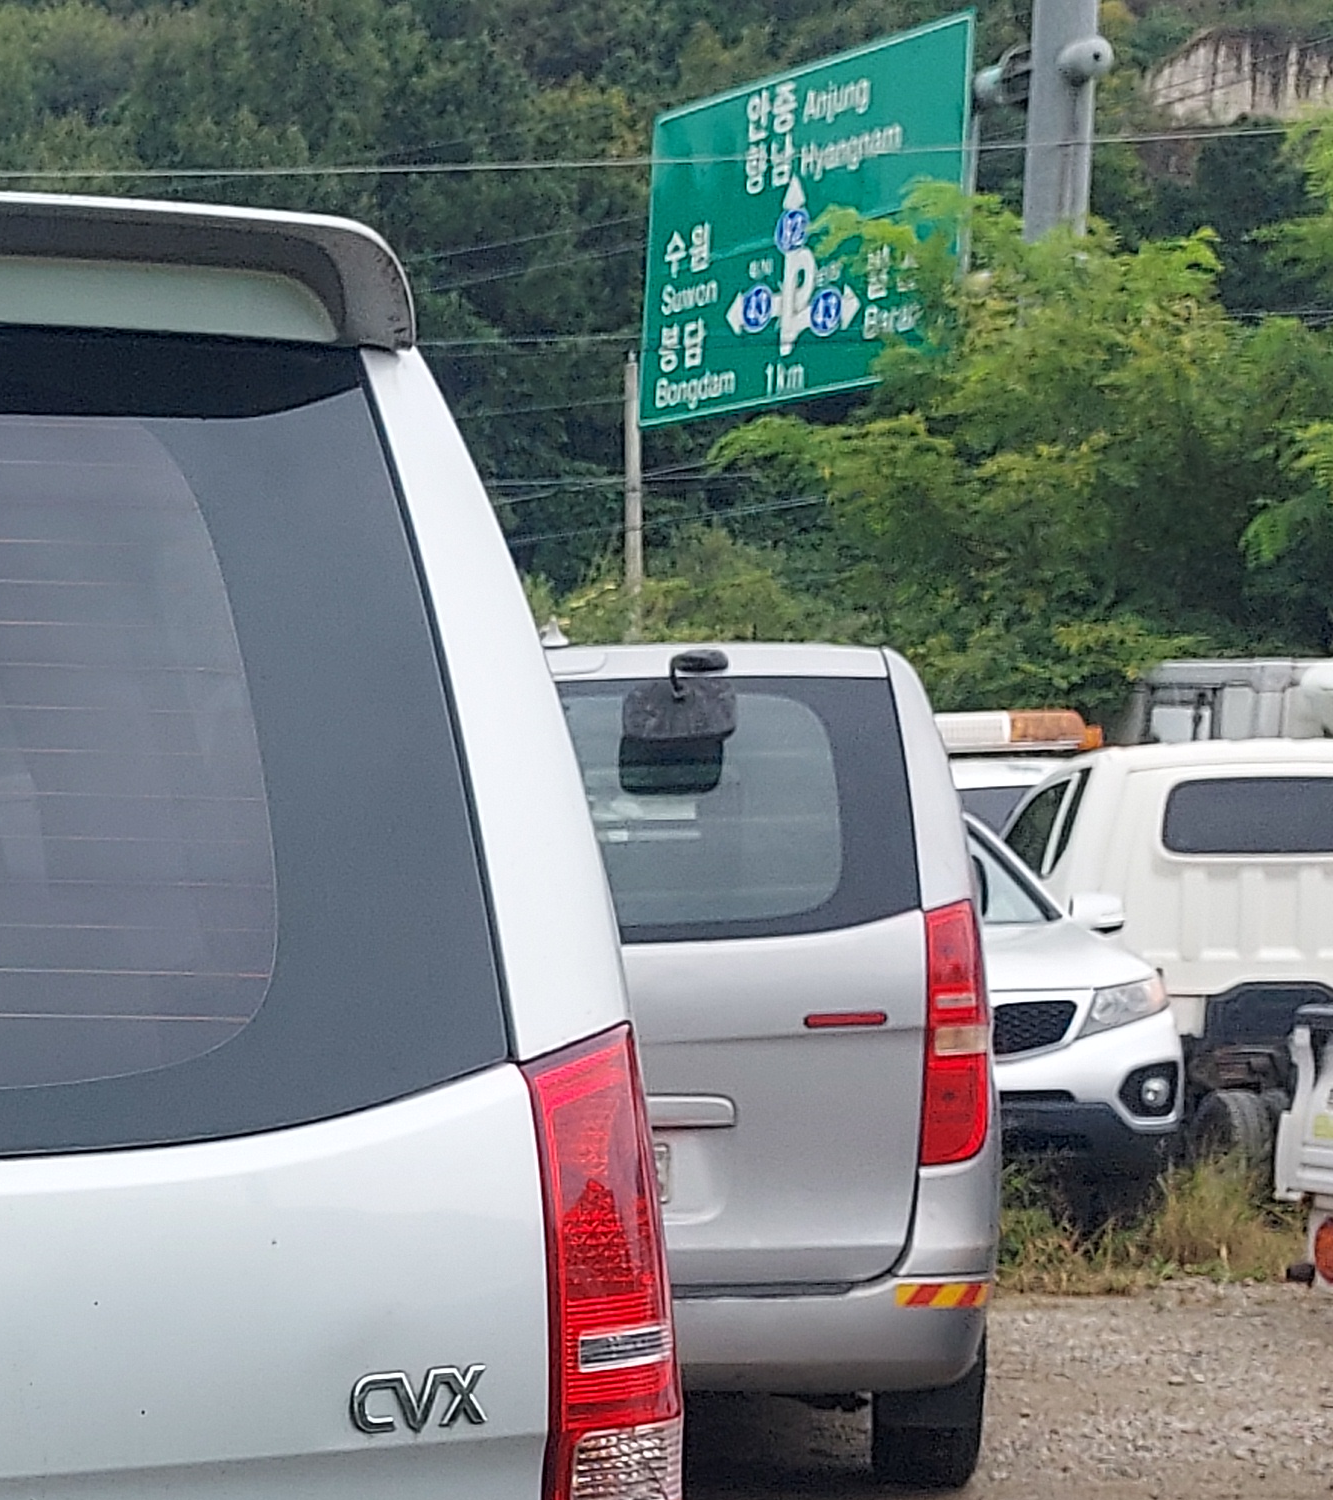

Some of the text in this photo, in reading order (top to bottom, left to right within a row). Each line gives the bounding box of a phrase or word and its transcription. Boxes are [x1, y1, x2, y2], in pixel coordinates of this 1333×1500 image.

[747, 81, 798, 142] 안중
[803, 78, 871, 123] Anjung
[801, 123, 902, 181] Hyangnam
[664, 221, 711, 278] 수원
[661, 280, 718, 315] Suwon
[658, 317, 707, 372] 봉담
[656, 369, 735, 409] Bongdam
[350, 1363, 488, 1434] CVX
